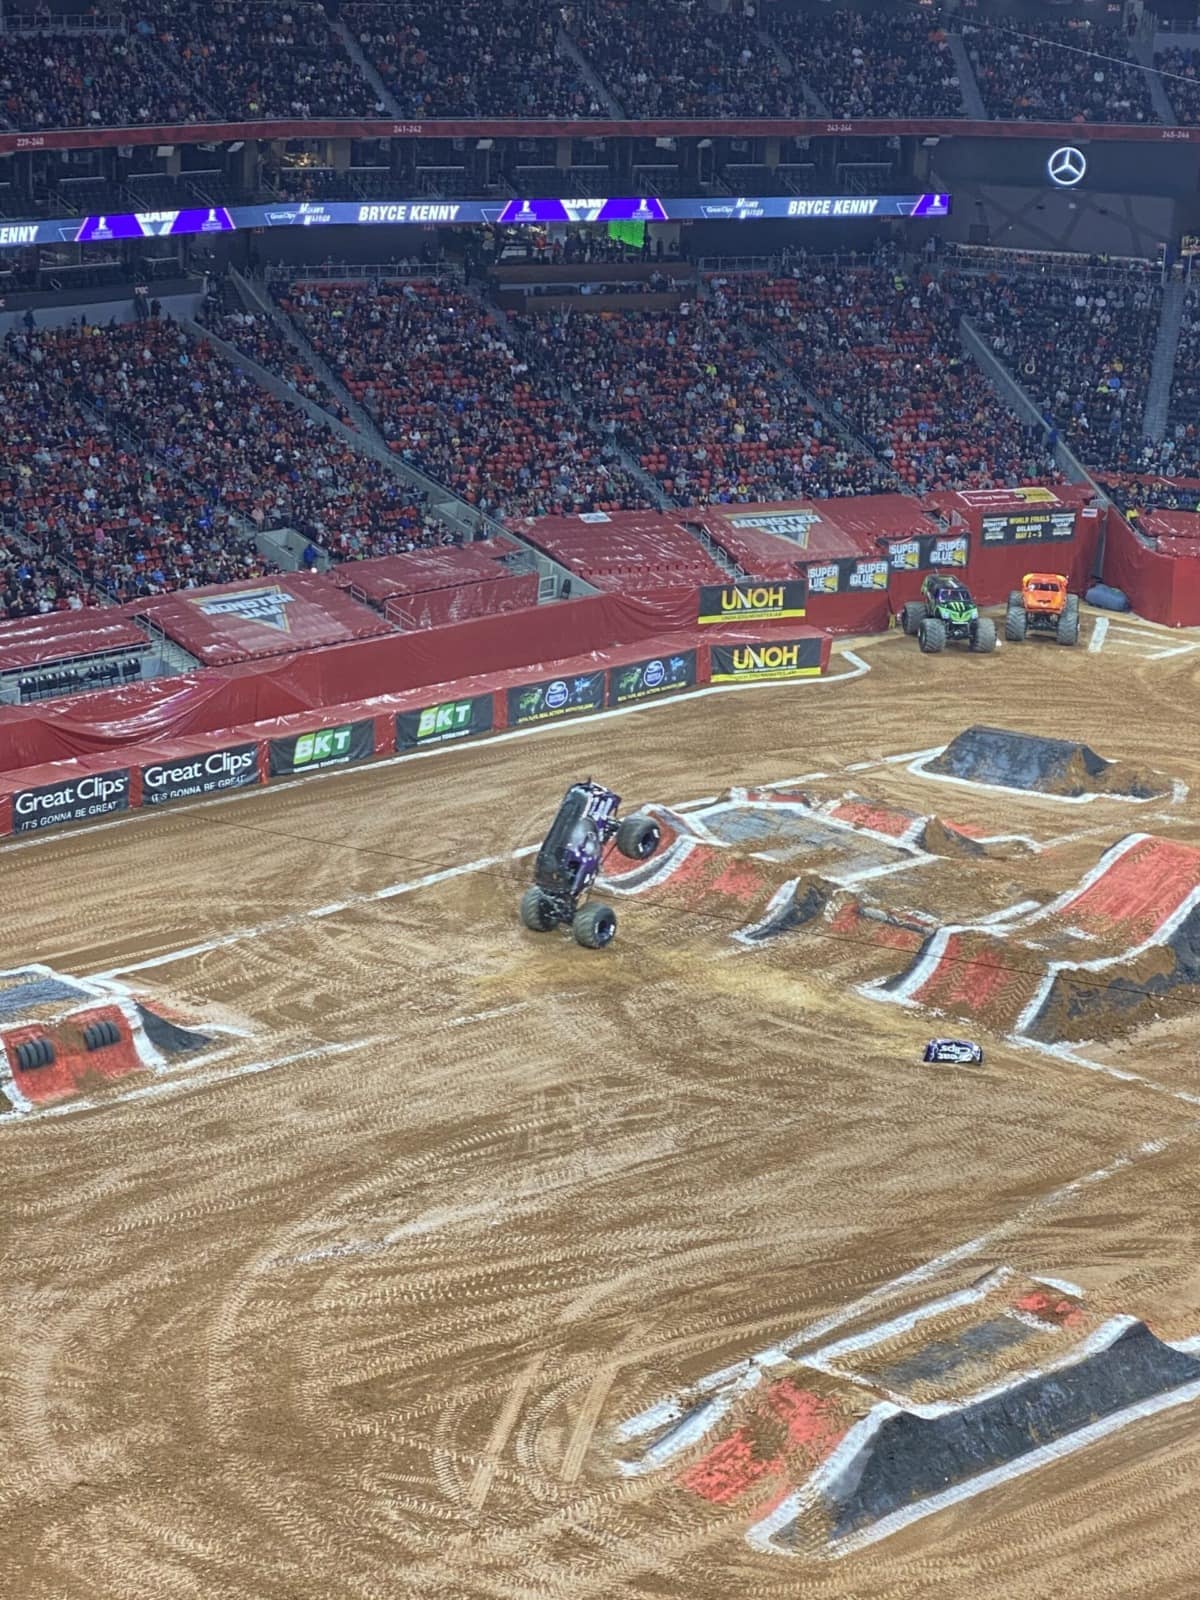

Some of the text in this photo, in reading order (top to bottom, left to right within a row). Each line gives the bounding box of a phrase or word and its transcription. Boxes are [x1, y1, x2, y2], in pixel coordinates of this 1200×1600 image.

[358, 204, 460, 221] BRYCE KENNY
[787, 199, 878, 215] BRYCE KENNY
[0, 225, 39, 243] ENNY
[731, 514, 824, 529] MONSTER
[889, 542, 919, 555] SUPER
[936, 538, 967, 551] SUPER
[809, 564, 839, 579] SUPER
[856, 561, 888, 575] SUPER
[200, 592, 296, 616] MONSTER
[721, 585, 784, 610] UNOH
[733, 644, 799, 670] UNOH
[418, 702, 470, 733] BKT
[294, 729, 350, 760] BKT
[144, 752, 252, 787] Great Clips
[15, 777, 124, 814] Great Clips
[170, 785, 201, 798] GONNA
[40, 811, 72, 826] GONNA
[74, 807, 87, 818] BE
[88, 801, 118, 815] GREAT
